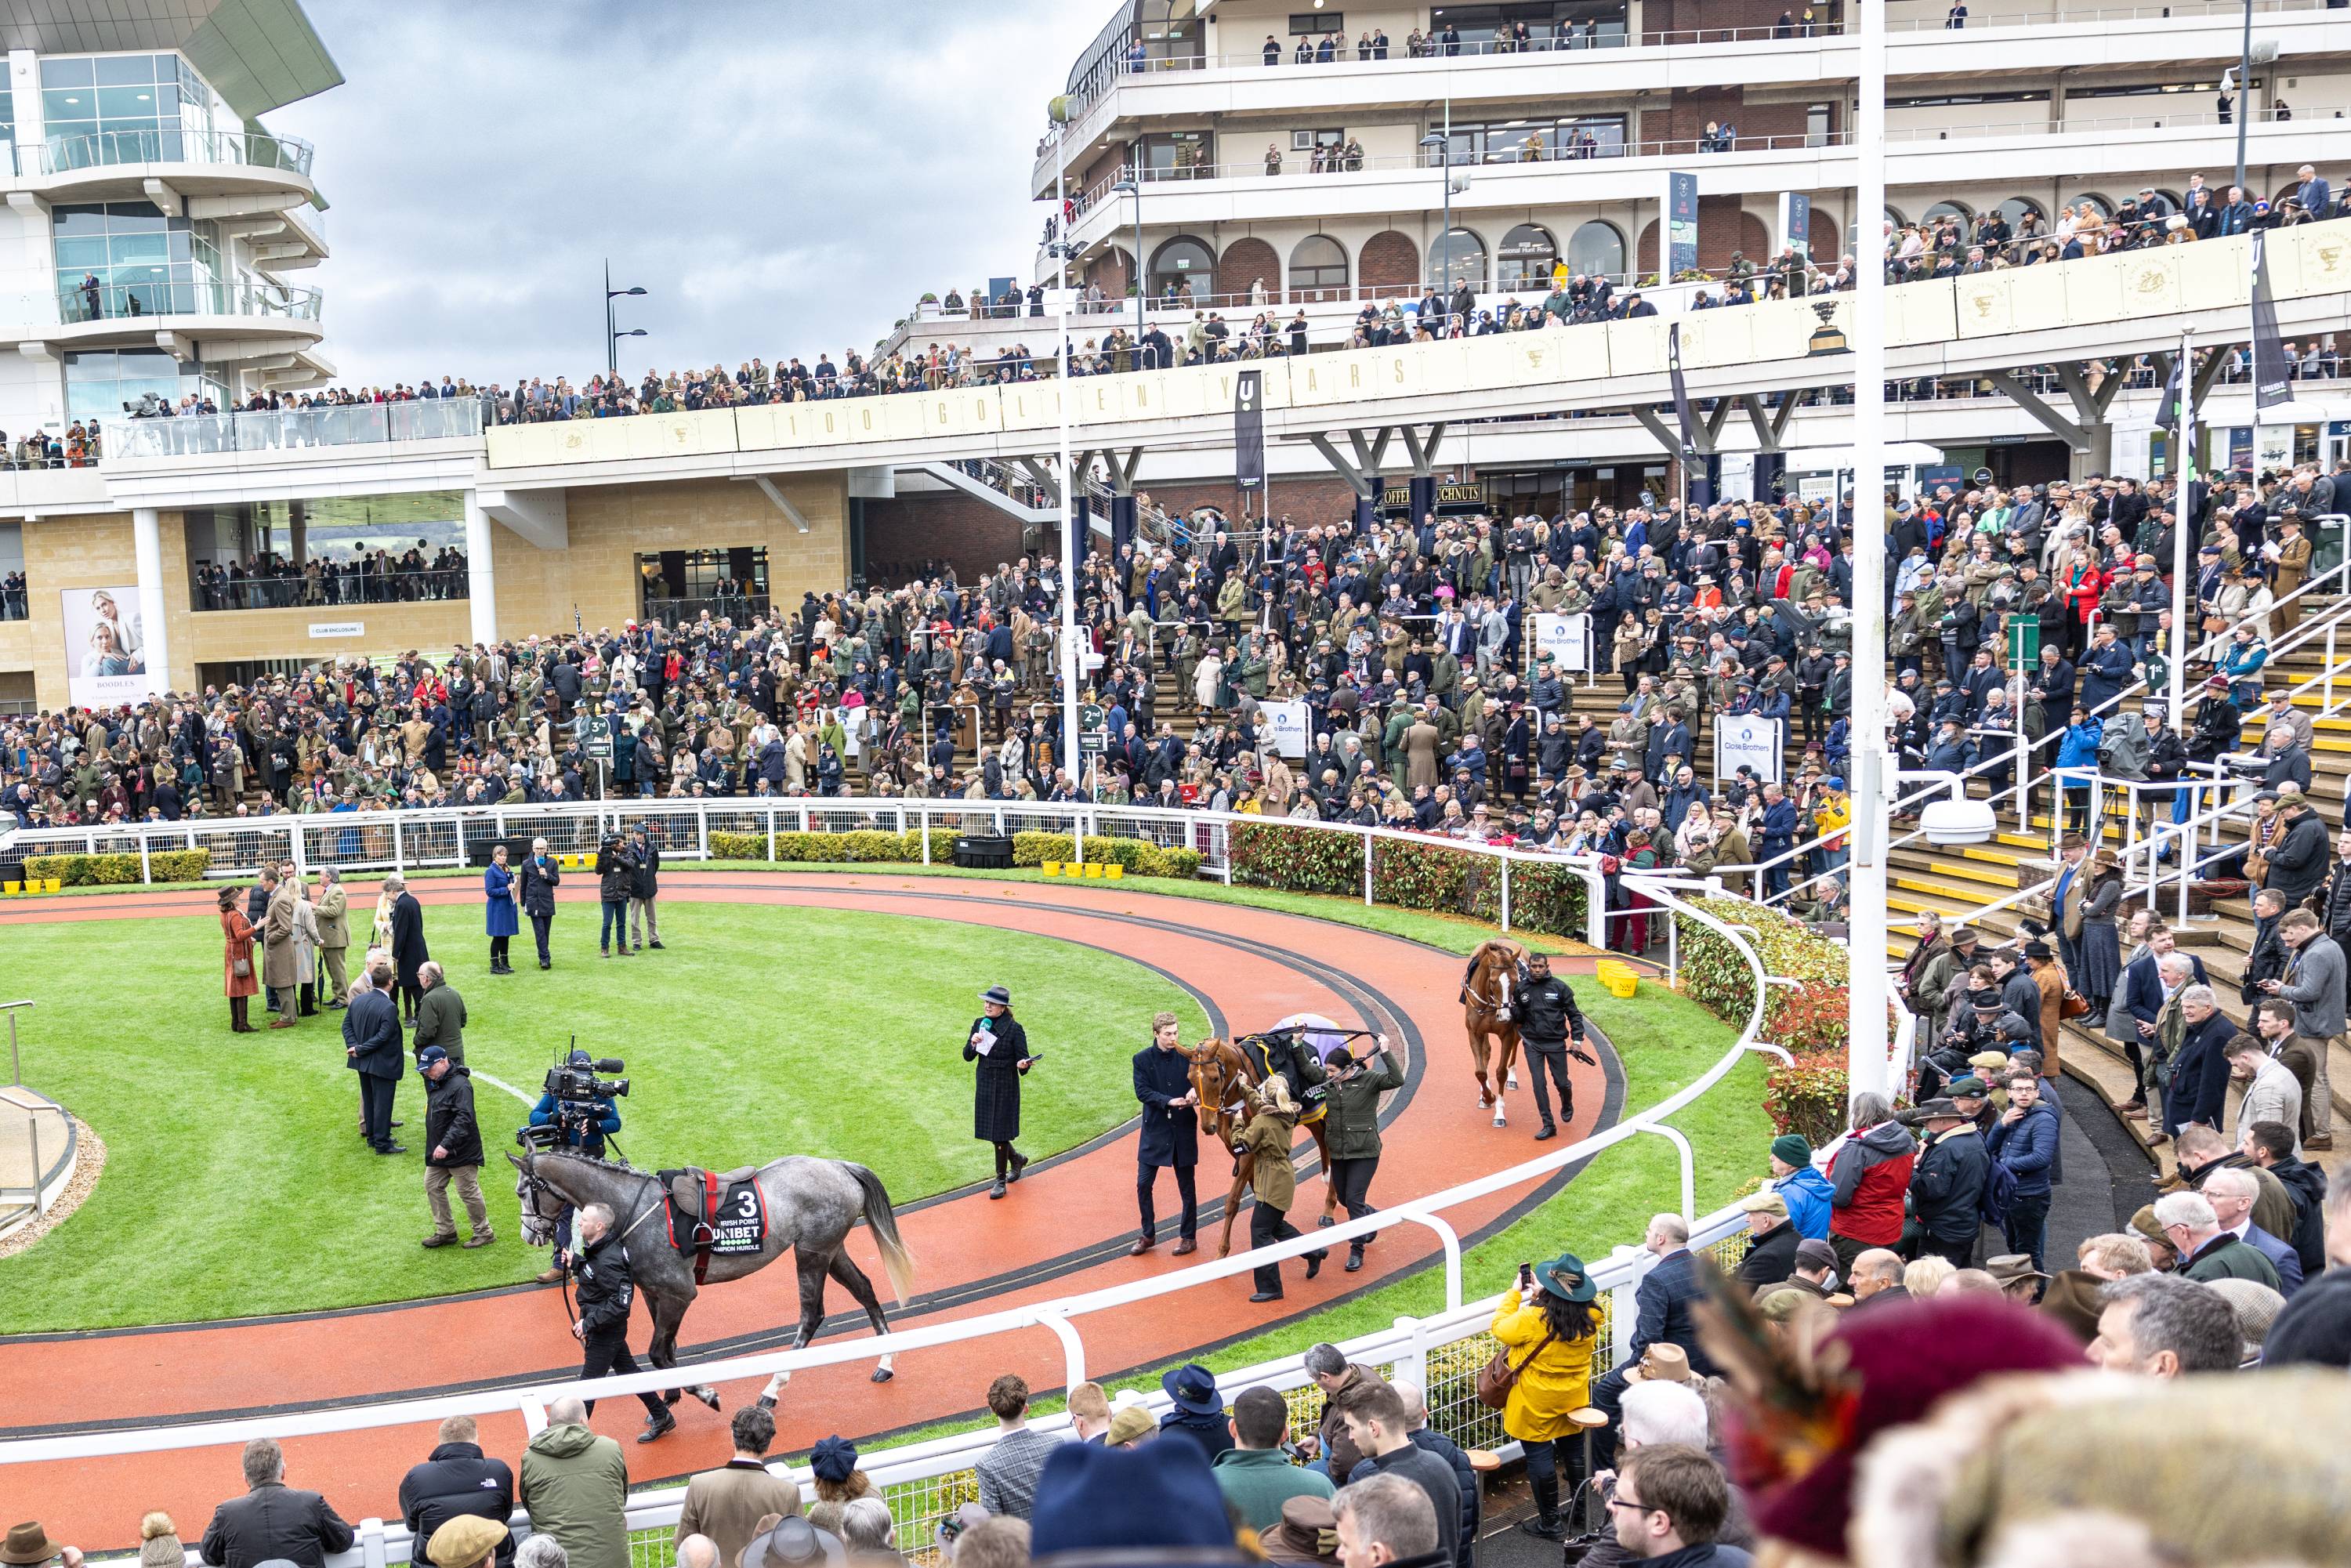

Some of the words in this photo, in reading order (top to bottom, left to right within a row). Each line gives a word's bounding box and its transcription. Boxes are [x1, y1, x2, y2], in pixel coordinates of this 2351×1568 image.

[790, 409, 871, 436] 100
[939, 384, 1147, 424] GOLEN
[1221, 359, 1404, 400] YEARS
[1385, 490, 1410, 504] OFFE
[1437, 487, 1479, 502] UGHNUTS
[2149, 664, 2163, 680] 1st
[1085, 709, 1100, 722] 2nd
[592, 722, 606, 733] 3rd
[1742, 743, 1770, 751] Brothers
[737, 1190, 757, 1218] 3
[712, 1226, 759, 1240] UNIBET
